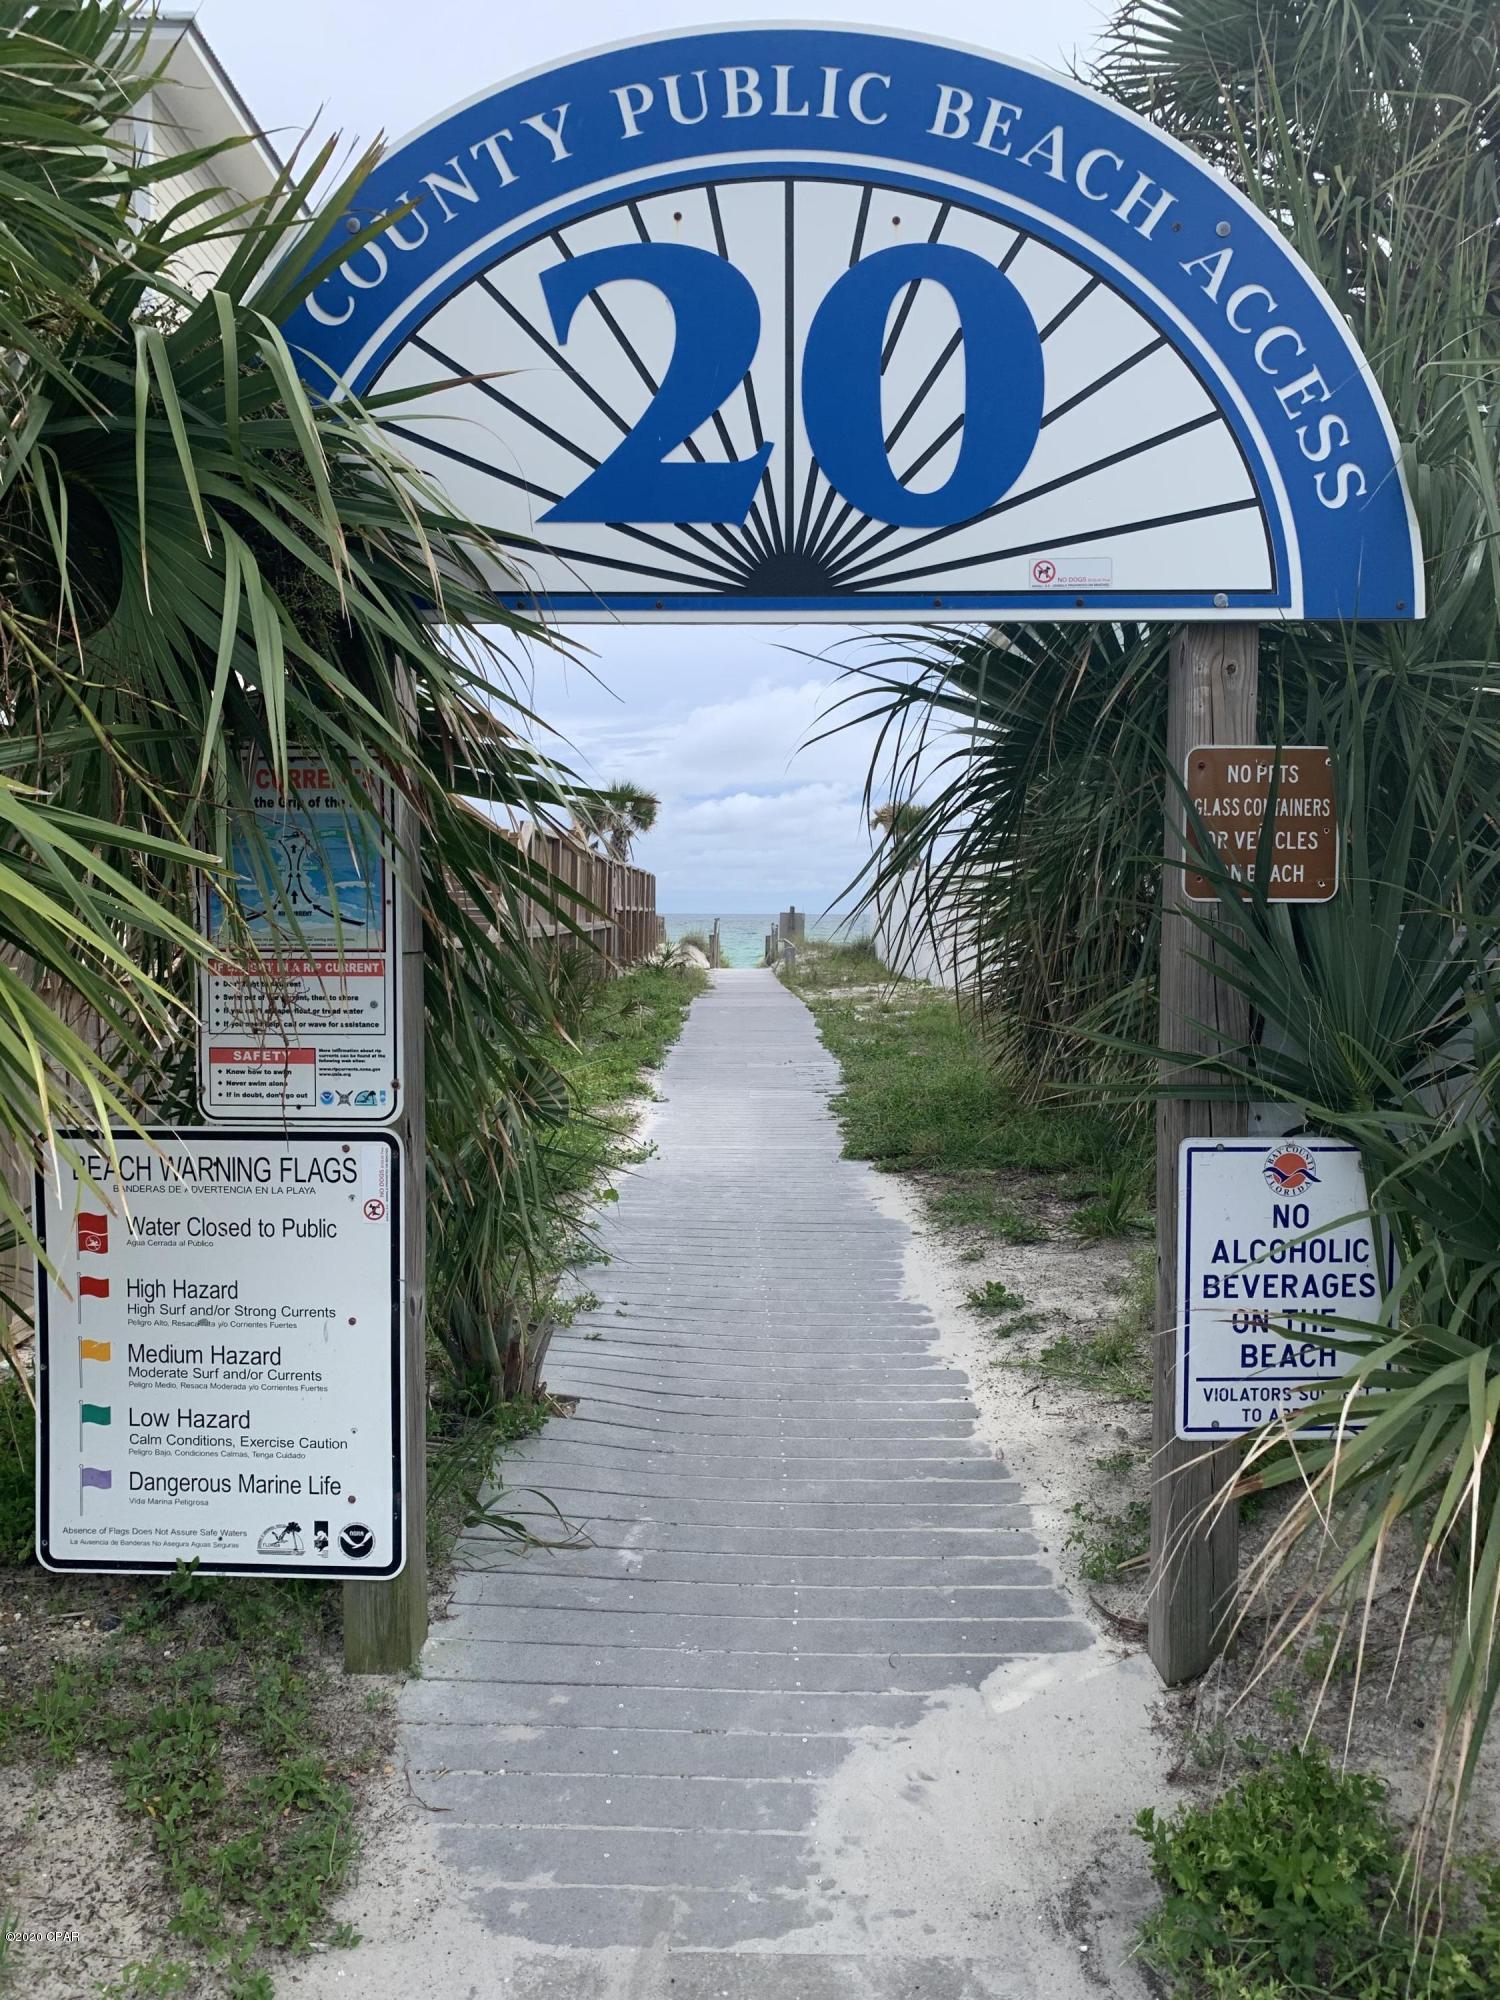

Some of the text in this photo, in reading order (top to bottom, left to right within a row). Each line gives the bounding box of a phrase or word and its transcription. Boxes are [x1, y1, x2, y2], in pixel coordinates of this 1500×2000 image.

[305, 64, 1368, 510] COUNTY PUBLIC BEACH ACCESS
[535, 241, 1046, 530] 20
[1228, 765, 1251, 784] NO
[254, 796, 274, 808] the
[308, 796, 321, 808] of
[1244, 798, 1330, 817] COTAINERS
[1234, 831, 1319, 850] VECLES
[1247, 864, 1304, 883] BACH
[233, 1050, 292, 1061] SAFETY
[1267, 1149, 1282, 1165] BAY
[160, 1156, 271, 1183] WARNING
[280, 1157, 358, 1184] FLAGS
[168, 1186, 182, 1194] DE
[255, 1186, 268, 1194] EN
[271, 1186, 284, 1194] LA
[286, 1186, 316, 1194] PLAYA
[1266, 1174, 1311, 1196] FLORIDA
[1272, 1204, 1310, 1229] NO
[126, 1216, 337, 1238] Water Closed to Public
[126, 1239, 146, 1247] Agua
[1211, 1239, 1369, 1264] ALCOHOLIC
[127, 1278, 238, 1303] High Hazard
[1203, 1273, 1376, 1299] BEVERAGES
[127, 1304, 336, 1320] High Surf and/or Strong Currents
[1232, 1308, 1336, 1333] ON THE
[127, 1319, 152, 1328] Peligro
[270, 1322, 298, 1330] Fuertes
[128, 1343, 282, 1366] Medium Hazard
[1240, 1344, 1336, 1369] BEACH
[128, 1366, 322, 1381] Moderate Surf and/or Currents
[128, 1381, 153, 1390] Peligro
[180, 1382, 208, 1390] Resaca
[210, 1382, 246, 1391] Moderada
[300, 1384, 328, 1392] Fuertes
[1203, 1388, 1292, 1402] VIOLATORS
[129, 1408, 250, 1429] Low Hazard
[1242, 1408, 1262, 1422] TO
[129, 1434, 348, 1450] Calm Conditions, Exercise Caution
[128, 1448, 152, 1457] Peligro
[252, 1452, 273, 1460] Tenga
[276, 1452, 306, 1460] Cuidado
[129, 1471, 342, 1496] Dangerous Marine Life
[148, 1498, 172, 1506] Marina
[62, 1526, 248, 1538] Absence of Flags Does Not Assure Safe Waters
[163, 1541, 190, 1550] Asegura
[191, 1542, 212, 1550] Aguas
[212, 1542, 240, 1550] Seguras
